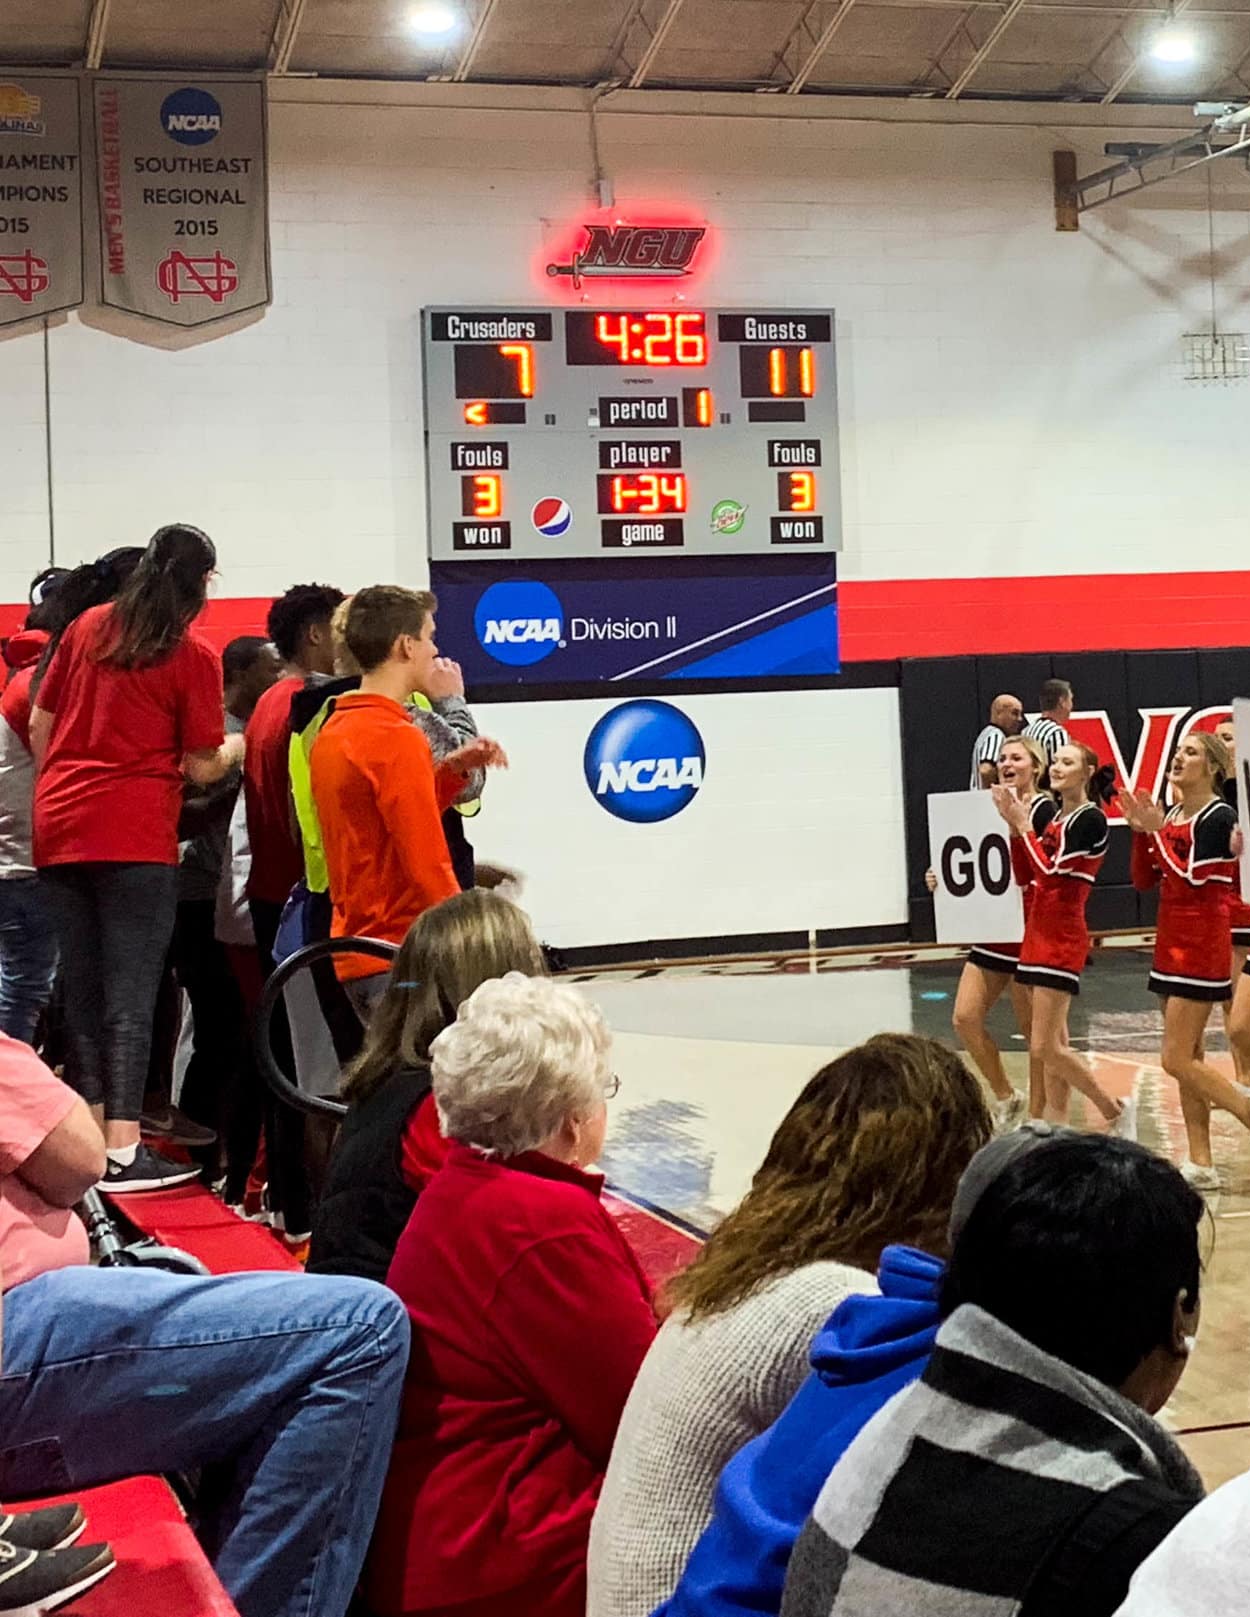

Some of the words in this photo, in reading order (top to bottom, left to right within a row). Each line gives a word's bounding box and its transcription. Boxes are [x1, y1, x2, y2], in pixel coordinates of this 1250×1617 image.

[168, 114, 221, 131] NCAA
[134, 157, 252, 174] SOUTHEAST
[143, 188, 247, 205] REGIONAL
[174, 219, 219, 236] 2015
[583, 224, 706, 267] NGU
[447, 315, 536, 339] Crusaders
[595, 313, 706, 364] 4:26
[744, 318, 807, 340] Guests
[500, 344, 533, 396] 7
[609, 397, 668, 425] period
[457, 446, 503, 467] fouls
[610, 441, 671, 469] player
[773, 442, 816, 465] fouls
[474, 475, 499, 516] 3
[790, 471, 814, 512] 3
[463, 526, 502, 545] won
[621, 523, 665, 547] game
[780, 519, 815, 539] won
[484, 617, 562, 644] NCAA
[570, 617, 659, 642] Division
[666, 615, 677, 639] II
[595, 755, 703, 795] NCAA
[939, 834, 1012, 898] GO
